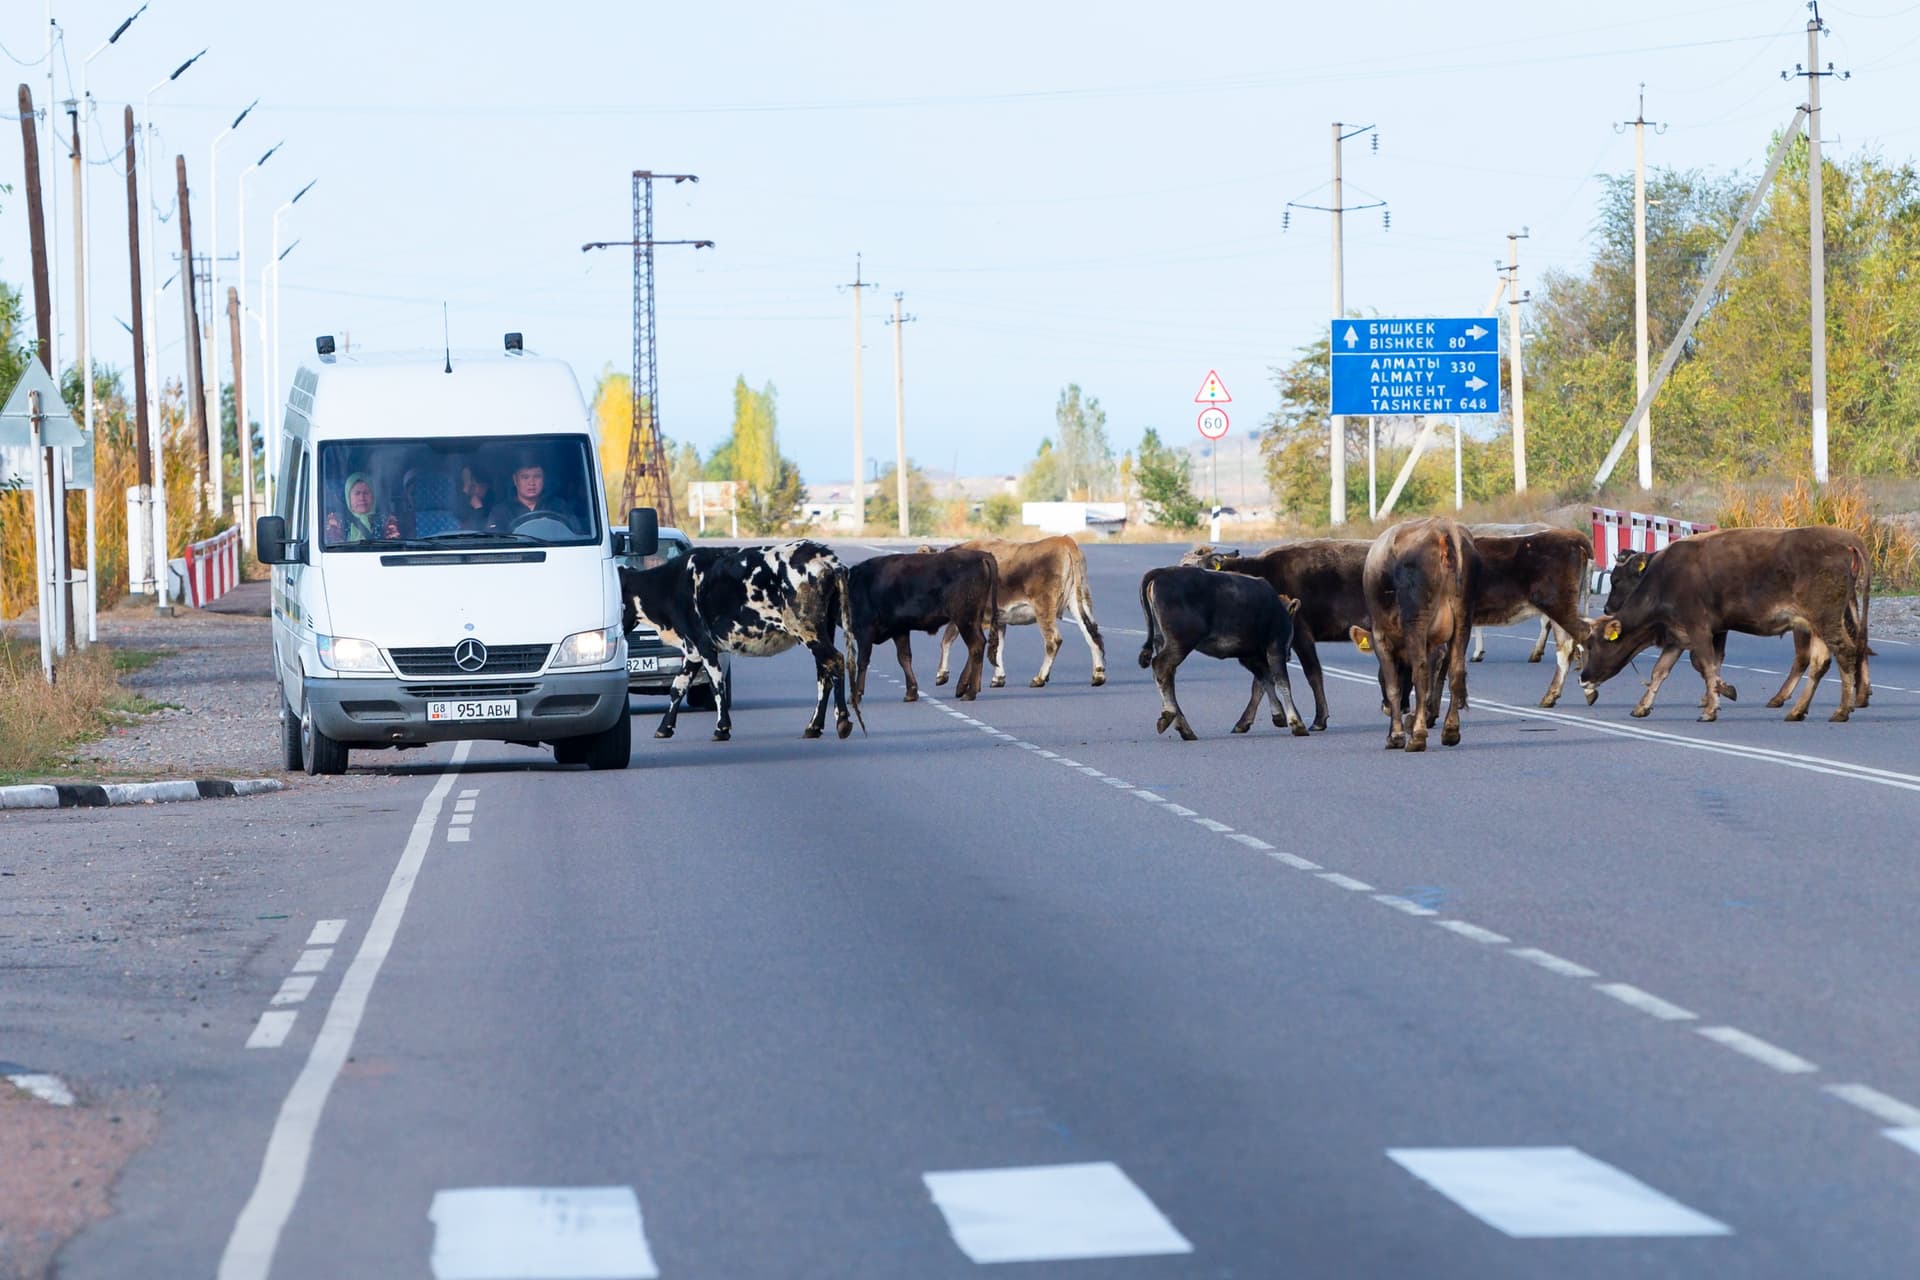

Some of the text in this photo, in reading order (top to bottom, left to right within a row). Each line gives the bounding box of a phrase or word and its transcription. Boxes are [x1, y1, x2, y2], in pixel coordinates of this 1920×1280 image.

[1370, 323, 1435, 335] БИШКЕК
[1370, 337, 1466, 350] BISHKEK 80
[1371, 358, 1476, 373] АЛМАТЫ 330
[1371, 371, 1434, 383] ALMATY
[1371, 385, 1446, 397] ТАШКЕНТ
[1371, 398, 1487, 411] TASHKENT 648
[1204, 417, 1222, 429] 60
[642, 658, 653, 670] M
[433, 703, 446, 713] 08
[457, 703, 484, 718] 951
[487, 704, 511, 717] ABW
